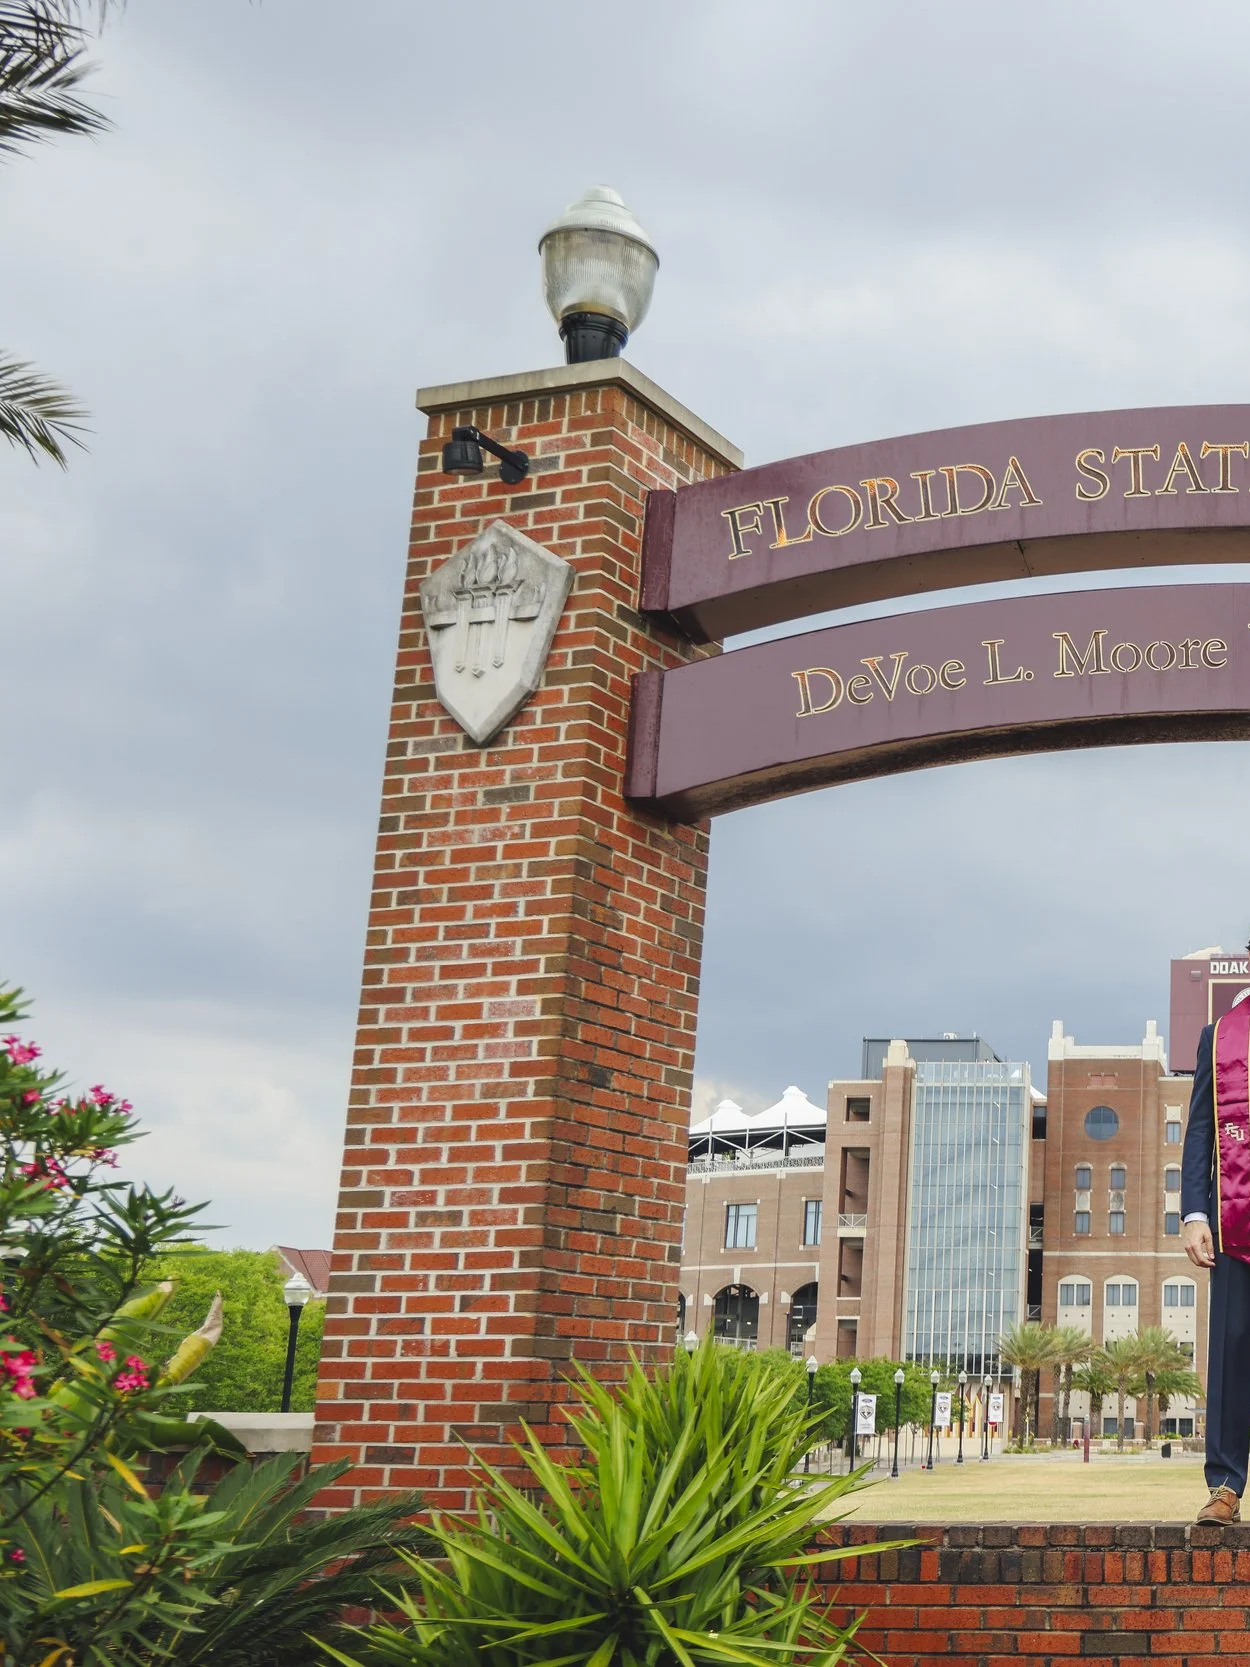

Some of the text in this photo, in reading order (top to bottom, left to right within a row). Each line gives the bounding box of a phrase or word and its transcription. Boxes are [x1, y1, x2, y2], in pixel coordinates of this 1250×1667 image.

[720, 456, 1043, 560] FLORIDA
[791, 651, 967, 718] DeVoe
[981, 639, 1035, 686] L.
[1052, 629, 1228, 679] Moore
[1210, 961, 1249, 974] DOAK
[1224, 1122, 1245, 1142] FSU
